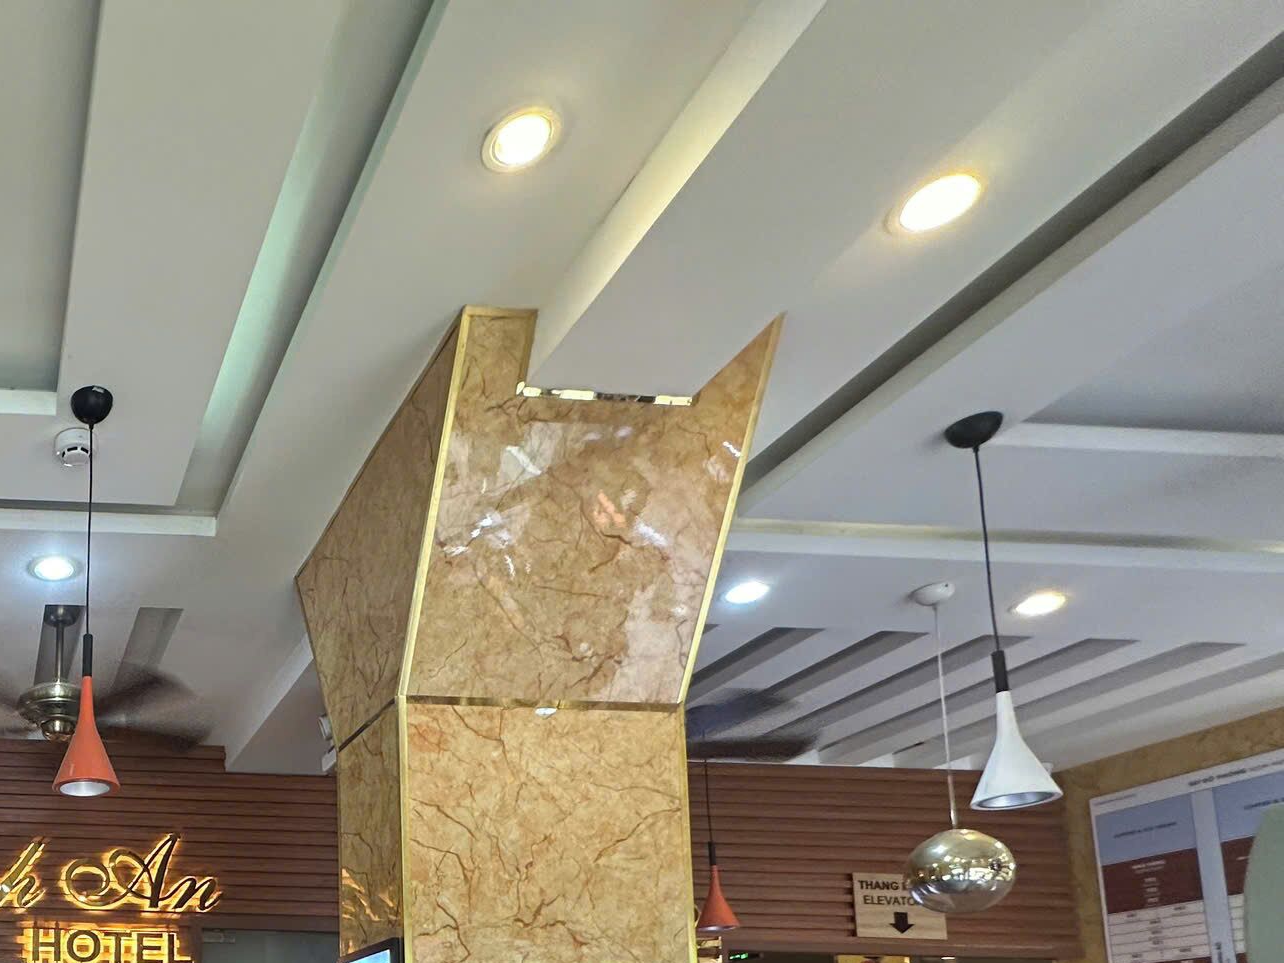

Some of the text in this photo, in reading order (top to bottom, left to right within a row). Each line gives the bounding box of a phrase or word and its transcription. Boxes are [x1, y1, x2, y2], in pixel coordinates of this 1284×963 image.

[66, 833, 223, 912] An
[858, 880, 899, 891] THANG
[863, 894, 917, 906] ELEVATO
